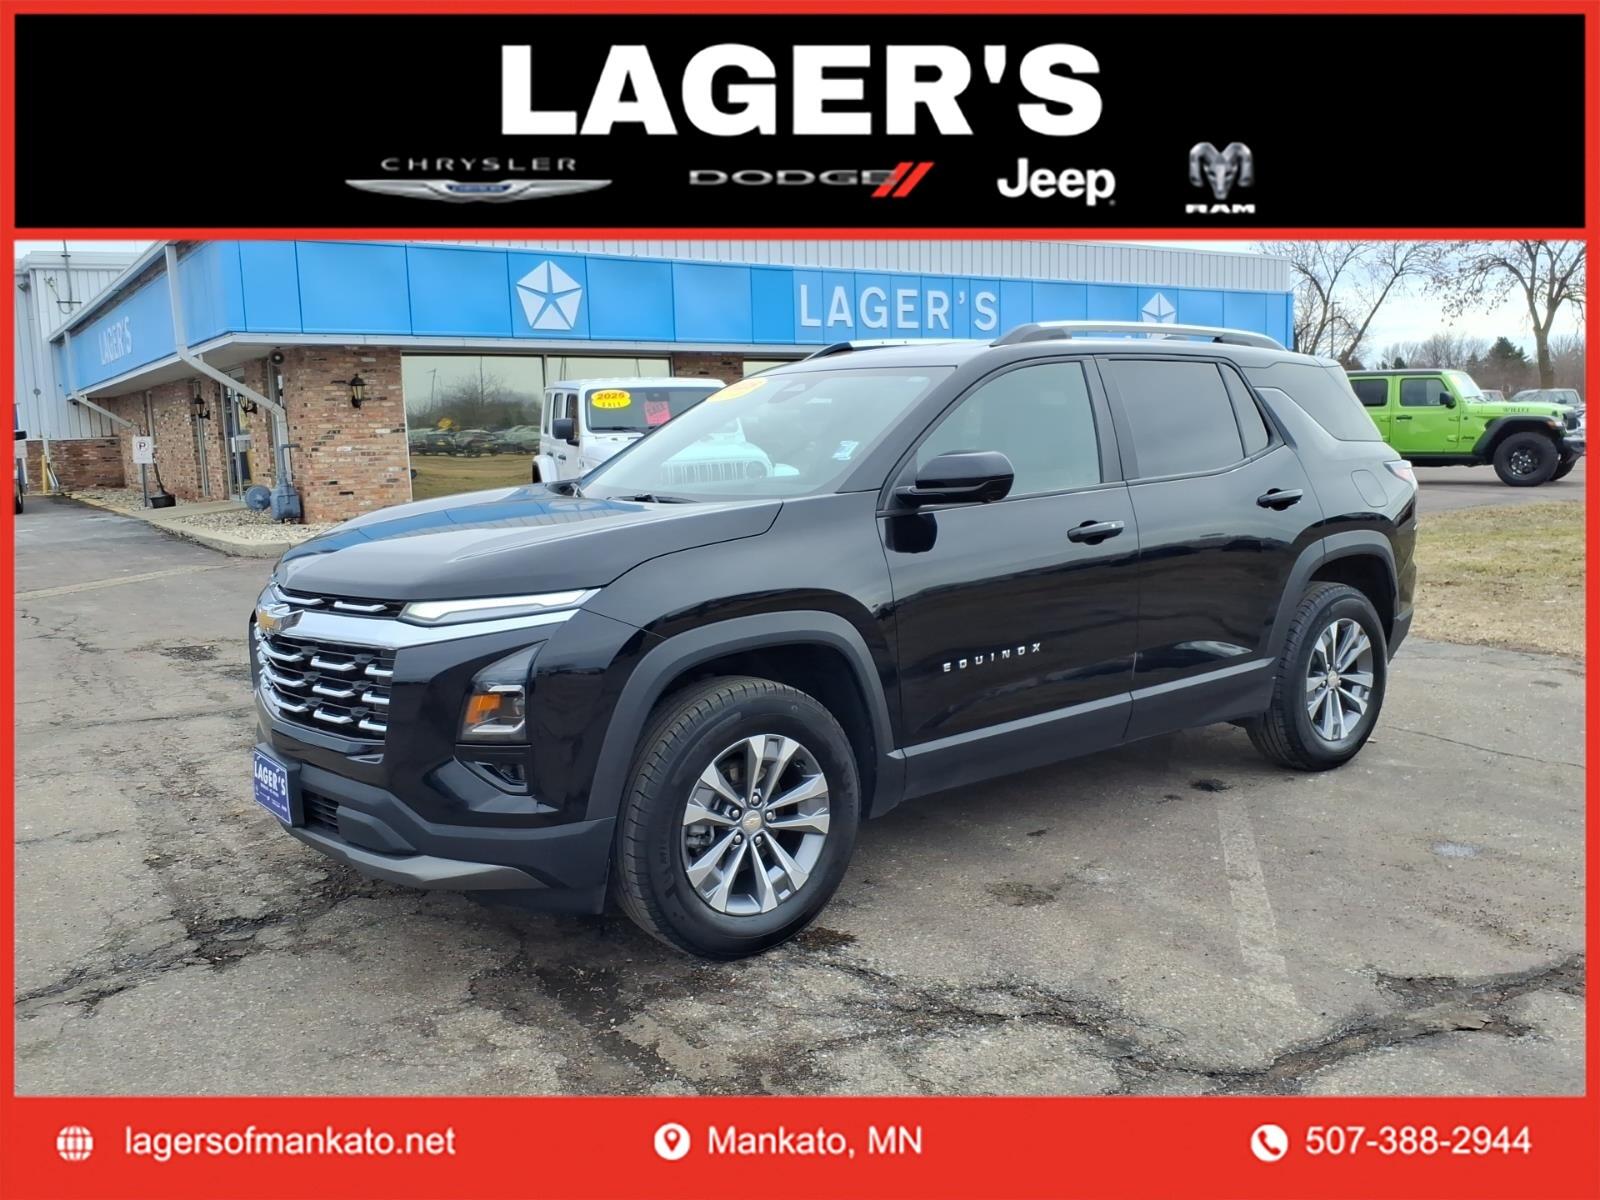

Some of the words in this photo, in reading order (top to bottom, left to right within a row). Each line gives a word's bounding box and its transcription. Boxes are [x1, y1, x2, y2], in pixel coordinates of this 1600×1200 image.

[800, 284, 998, 332] LAGER'S
[99, 316, 133, 365] LAGER'S
[943, 643, 1041, 673] EQUINOX
[254, 760, 286, 797] LAGER'S
